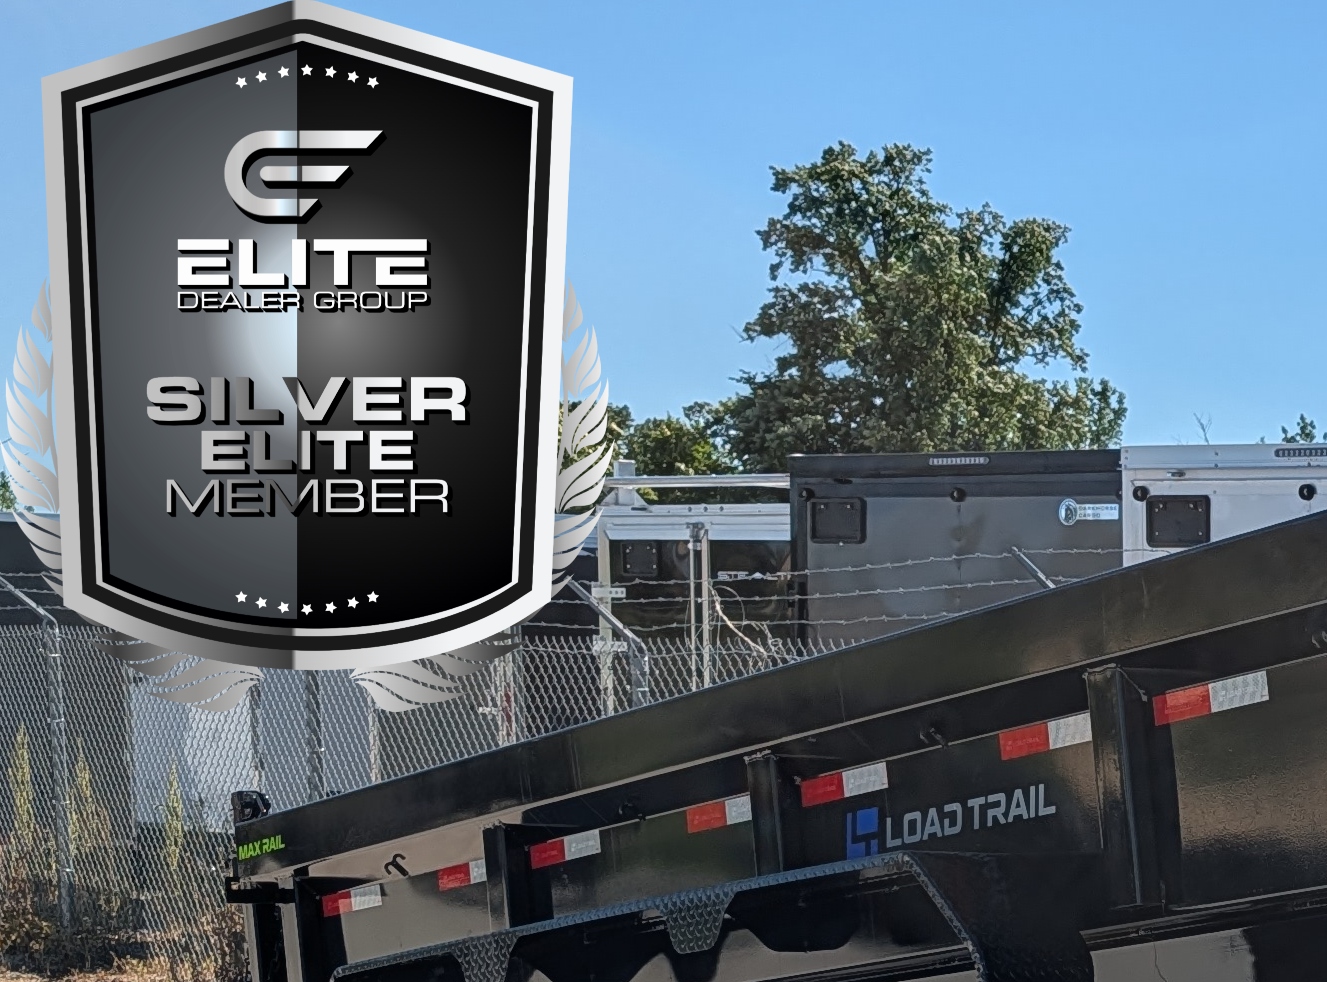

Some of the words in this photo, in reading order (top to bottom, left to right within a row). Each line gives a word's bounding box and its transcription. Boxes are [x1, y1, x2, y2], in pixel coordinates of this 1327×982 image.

[886, 803, 963, 848] LOAD
[967, 783, 1057, 830] TRAIL
[238, 841, 261, 860] MAX
[262, 834, 286, 853] RAIL
